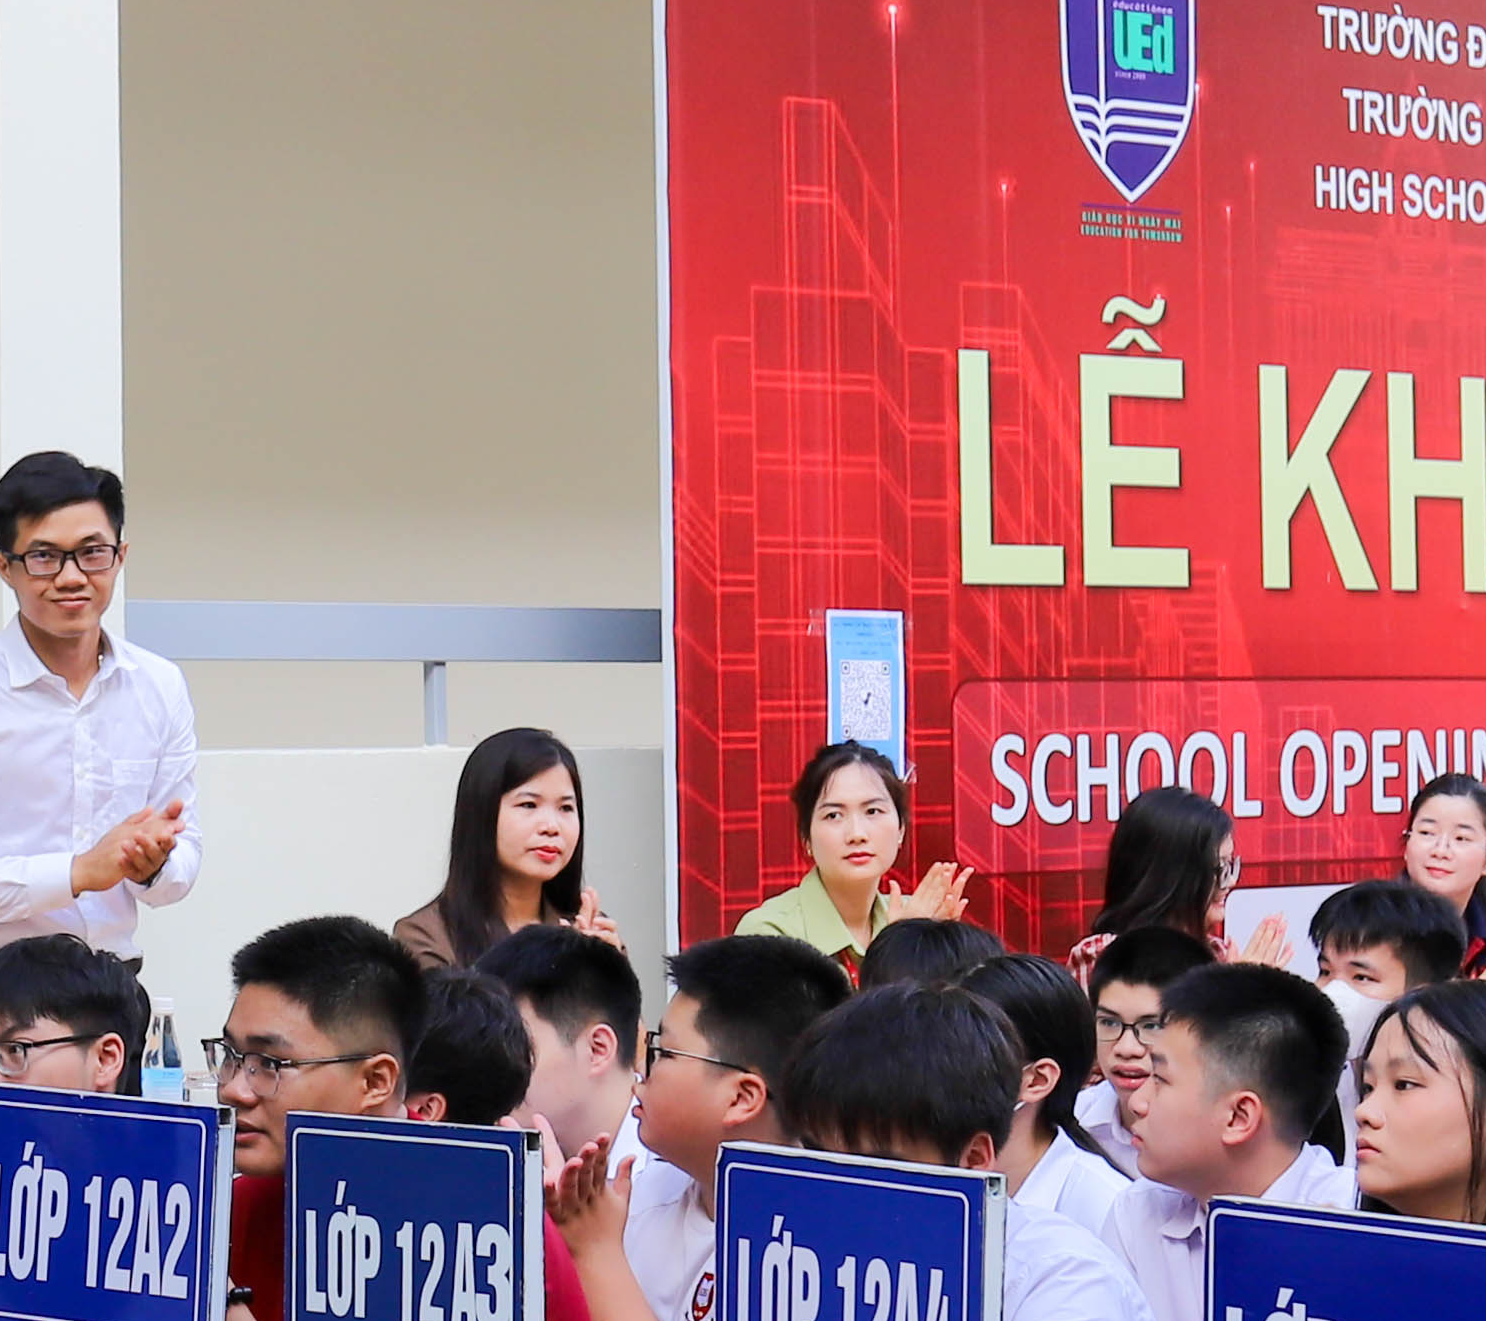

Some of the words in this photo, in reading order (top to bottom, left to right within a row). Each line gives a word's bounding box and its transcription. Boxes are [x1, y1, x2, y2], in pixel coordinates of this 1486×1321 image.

[1113, 9, 1176, 75] UEd
[1316, 3, 1459, 66] TRƯỜNG
[1342, 85, 1482, 146] TRƯỜNG
[1315, 164, 1394, 215] HIGH
[958, 295, 1191, 590] LỄ
[990, 729, 1263, 826] SCHOOL
[84, 1175, 193, 1300] 12A2
[303, 1180, 382, 1319] LỚP
